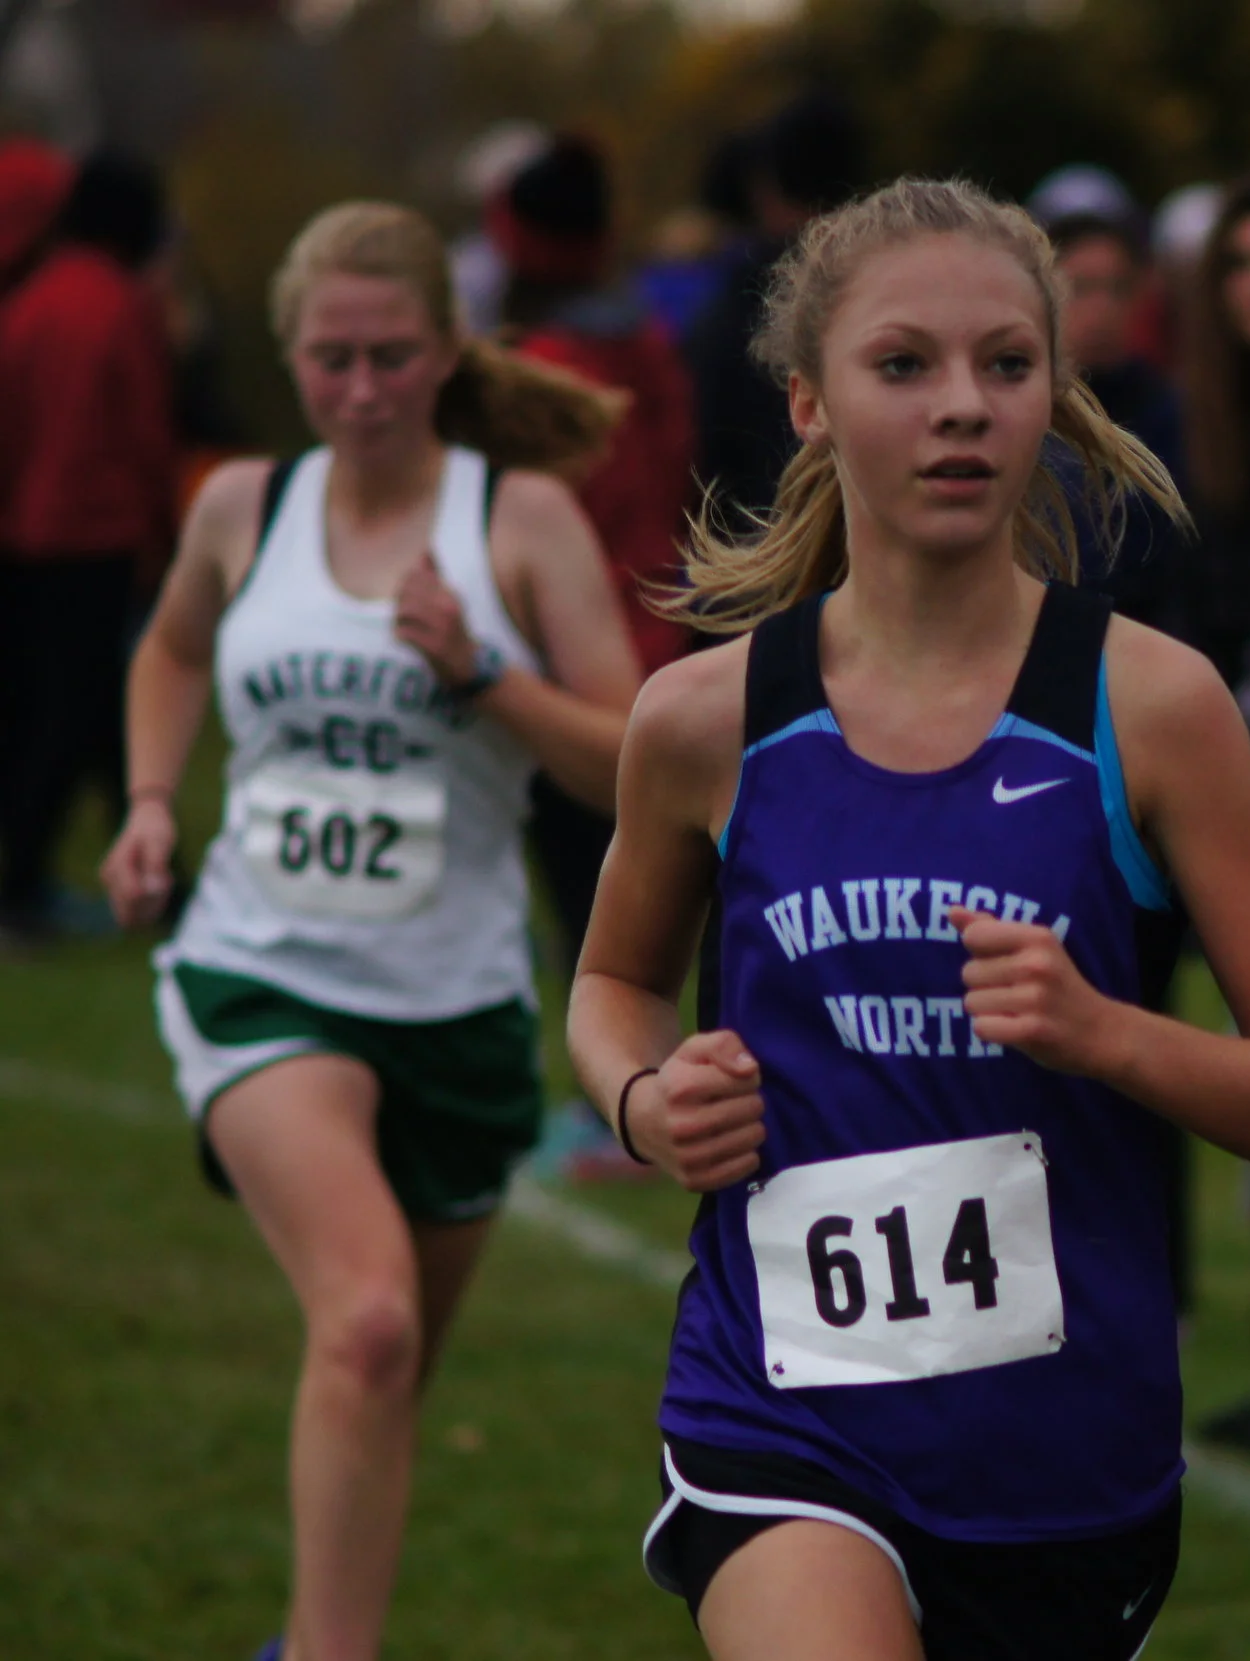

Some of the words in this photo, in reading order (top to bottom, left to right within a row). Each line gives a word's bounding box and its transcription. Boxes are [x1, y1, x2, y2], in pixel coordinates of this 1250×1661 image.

[244, 653, 460, 724] WATERFO
[281, 807, 401, 878] 602
[807, 1197, 999, 1328] 614
